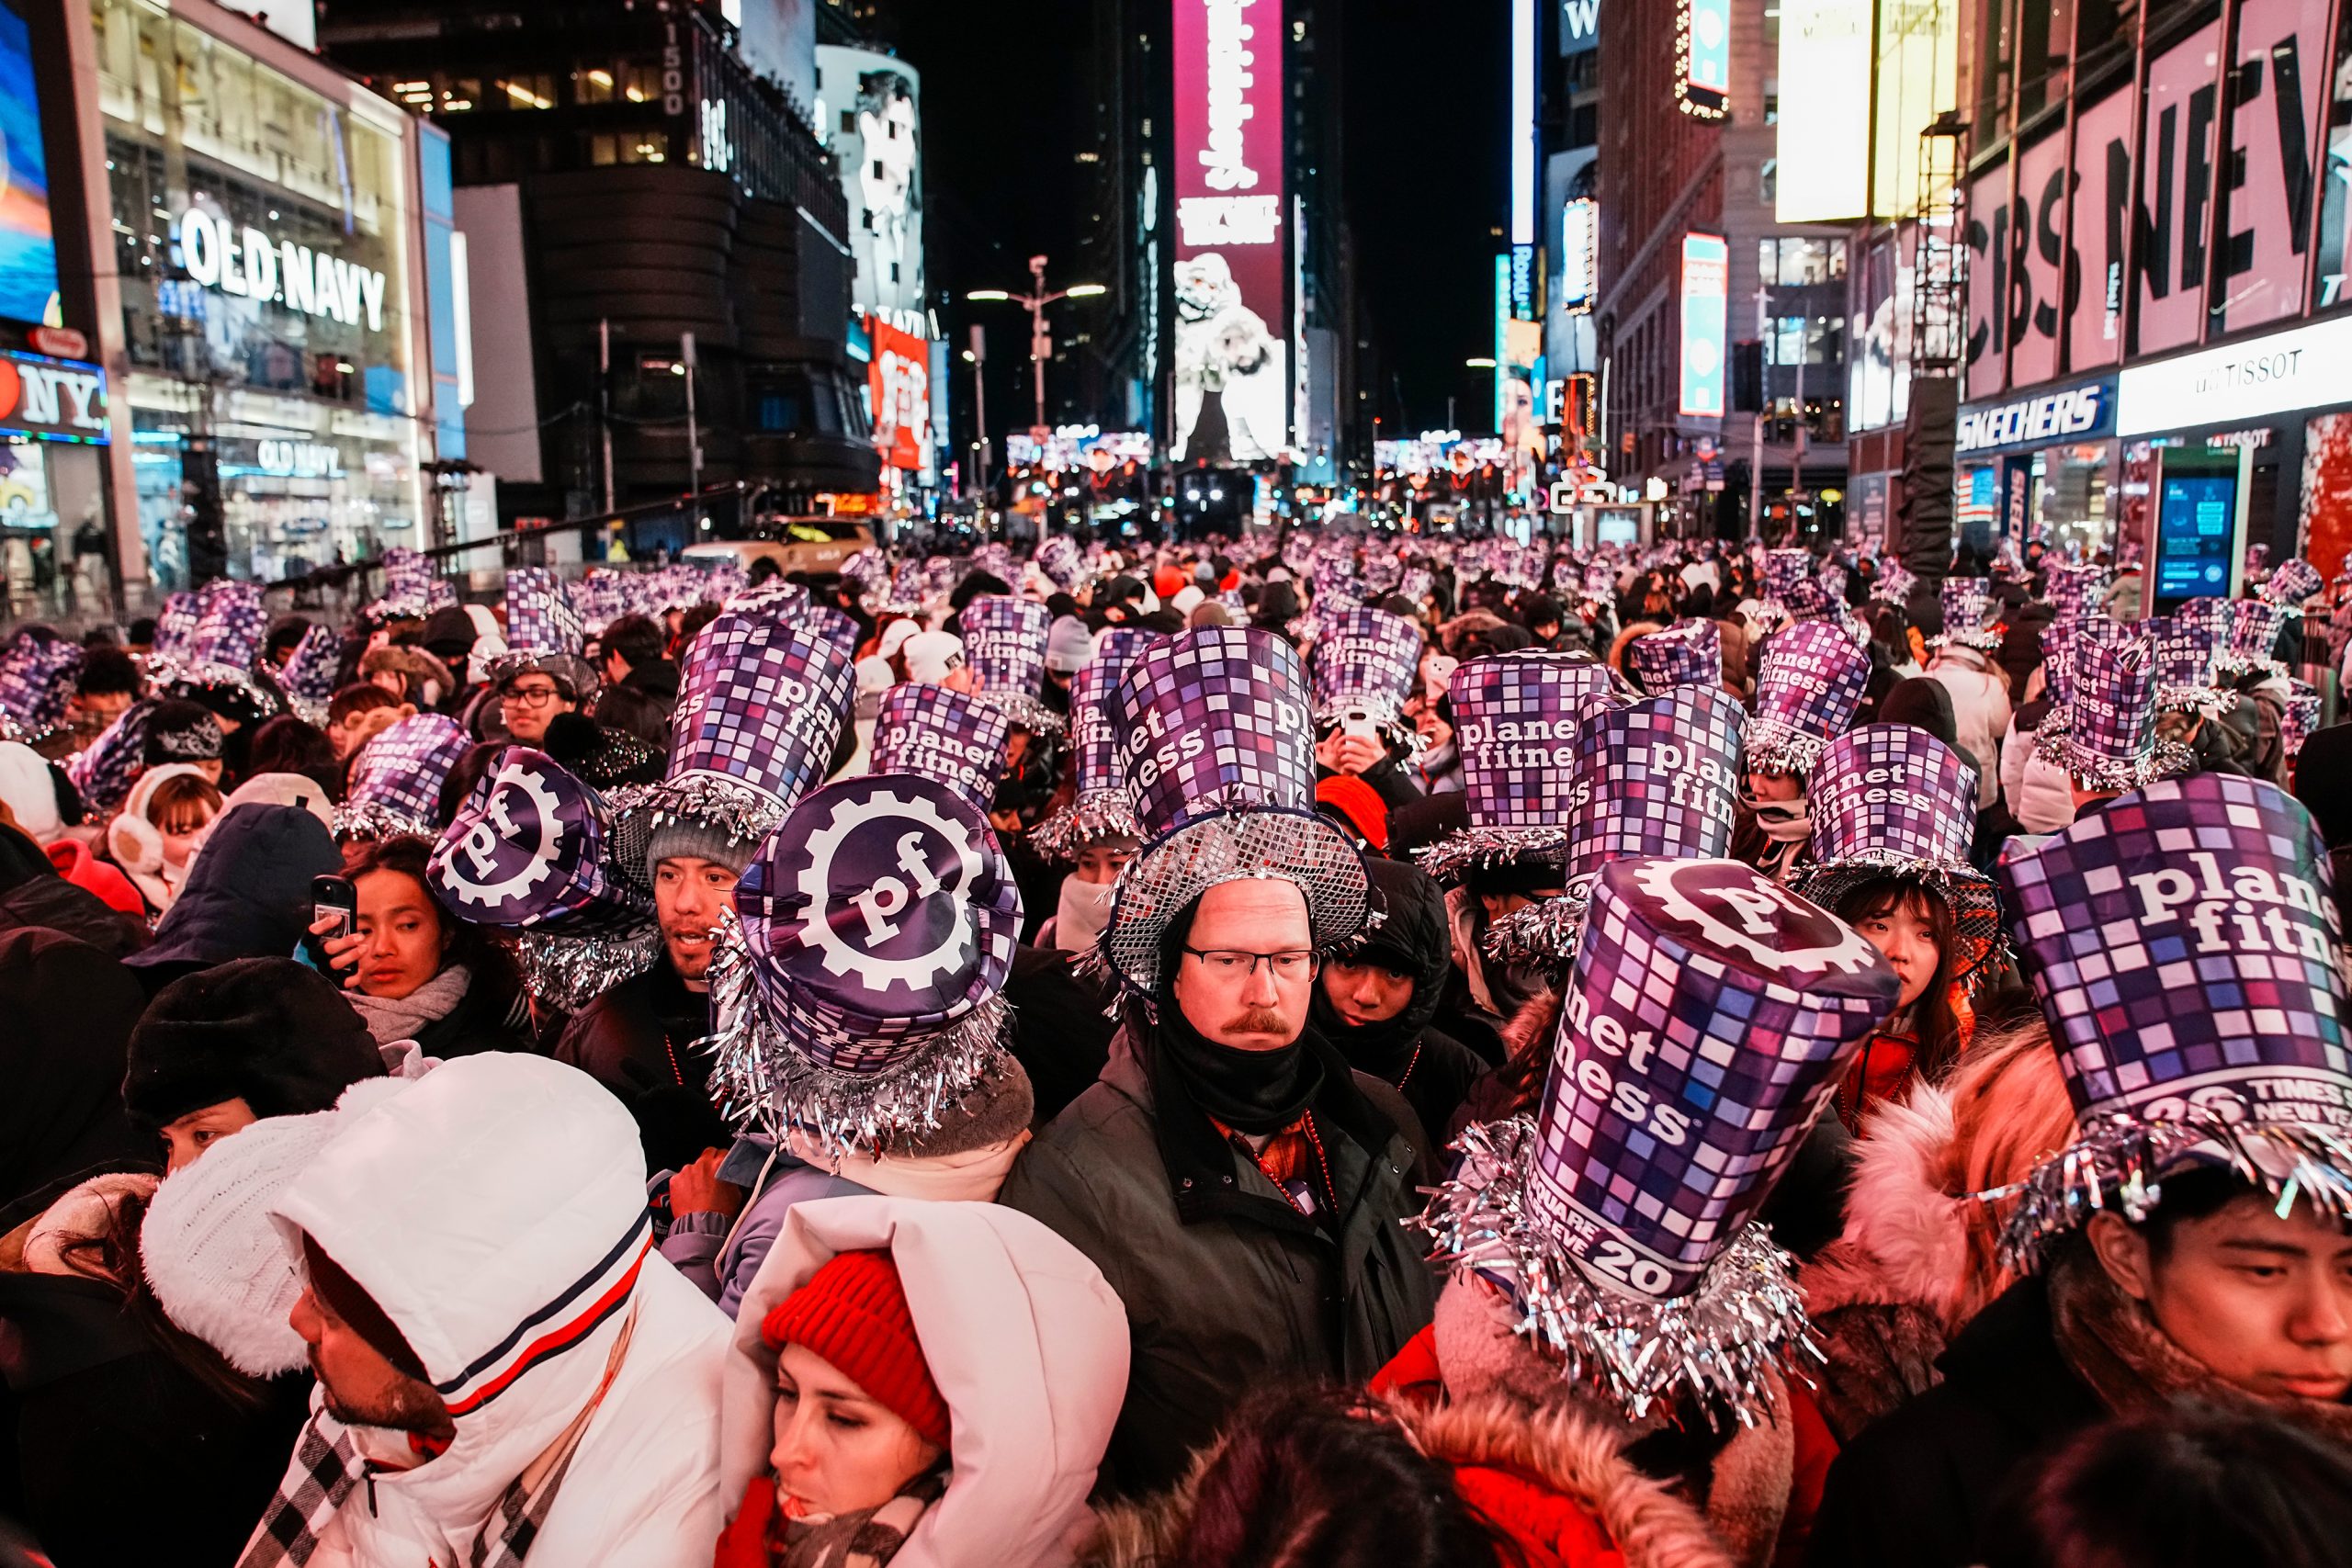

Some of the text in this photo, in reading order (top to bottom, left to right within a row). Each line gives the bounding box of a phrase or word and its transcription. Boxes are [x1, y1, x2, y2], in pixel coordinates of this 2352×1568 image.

[662, 22, 682, 115] 1500
[181, 208, 386, 333] OLD NAVY
[2225, 349, 2302, 388] TISSOT
[1955, 384, 2102, 452] SKECHERS
[967, 627, 1038, 649] planet
[975, 643, 1044, 668] fitness
[1323, 635, 1397, 660] planet
[1330, 649, 1408, 680] fitness
[1759, 649, 1822, 674] planet
[773, 675, 842, 749] plan
[888, 721, 995, 771] planet
[1461, 716, 1576, 751] plane
[897, 743, 996, 800] fitness
[1478, 742, 1574, 770] fitne
[460, 789, 522, 881] pf
[848, 830, 942, 949] pf
[2246, 1077, 2344, 1106] TIMES
[2253, 1101, 2321, 1122] NEW
[1551, 1222, 1589, 1258] EVE
[1592, 1239, 1673, 1295] 20
